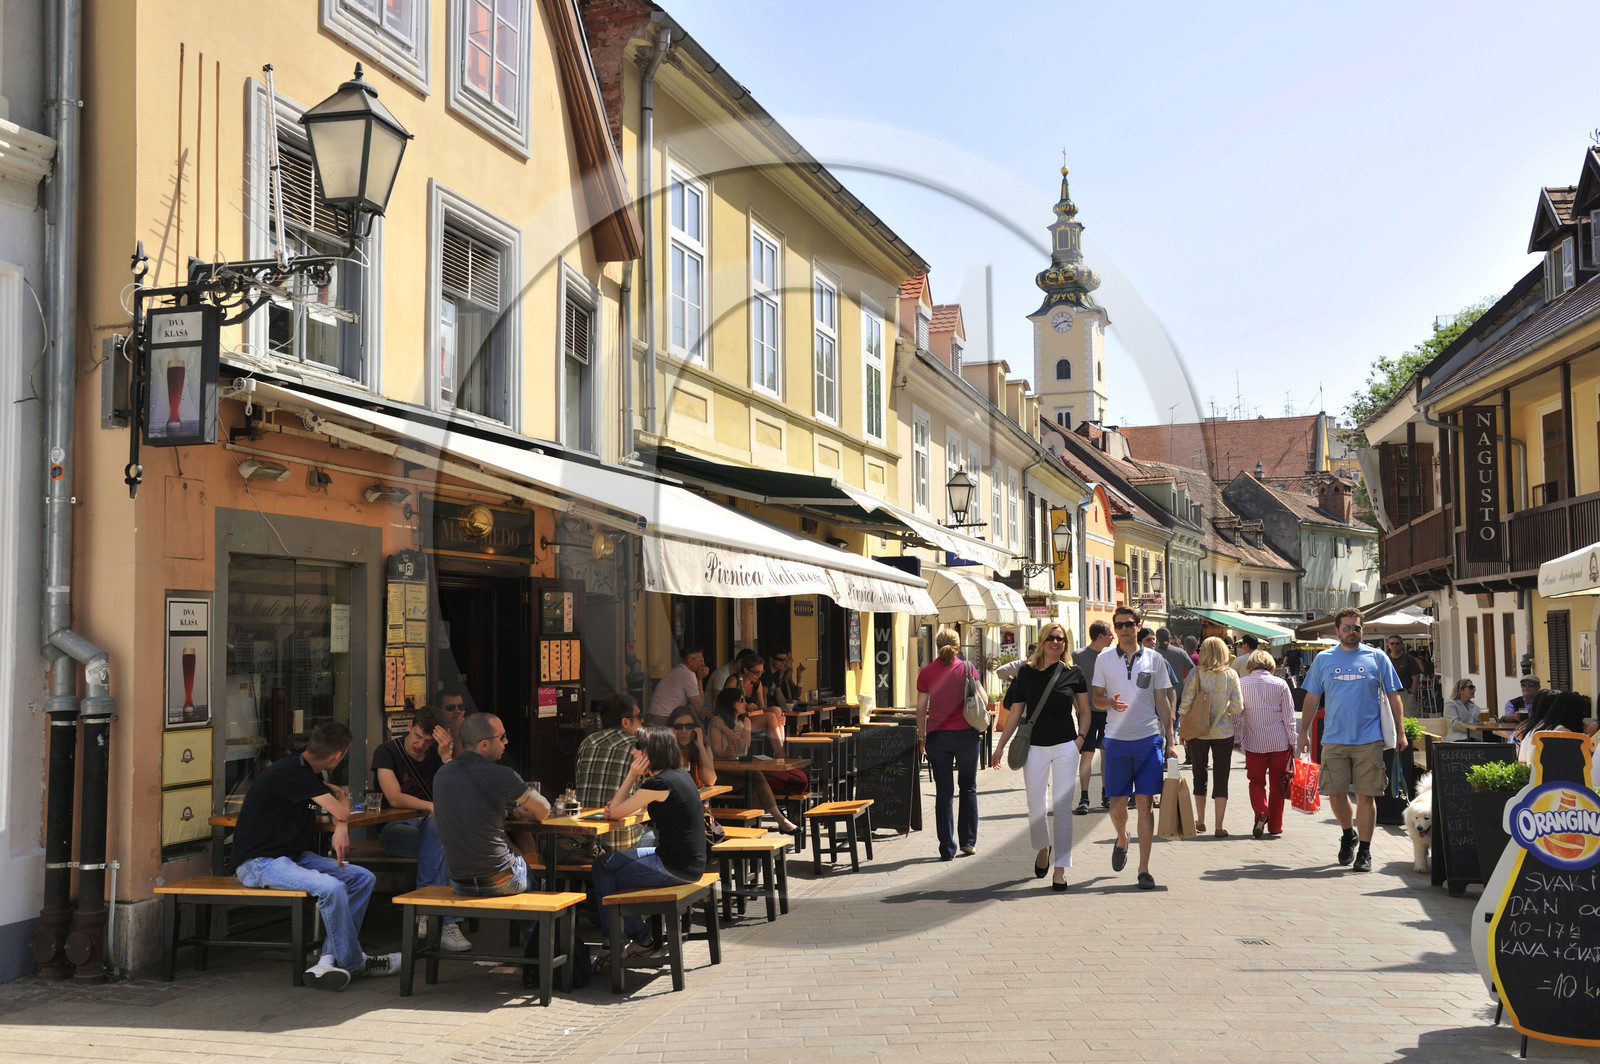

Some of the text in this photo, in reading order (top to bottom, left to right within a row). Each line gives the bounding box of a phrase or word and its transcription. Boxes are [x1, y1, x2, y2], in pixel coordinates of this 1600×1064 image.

[168, 319, 184, 327] DVA
[164, 329, 189, 338] KLASA
[1475, 412, 1496, 541] NAGUSTO
[704, 551, 764, 587] Pivnica
[874, 627, 891, 688] WOX
[539, 687, 556, 697] HotSpot
[1440, 749, 1486, 761] BURGER
[1518, 809, 1600, 841] ORANGIN
[1509, 895, 1558, 917] DAN
[1500, 939, 1549, 958] KAVA
